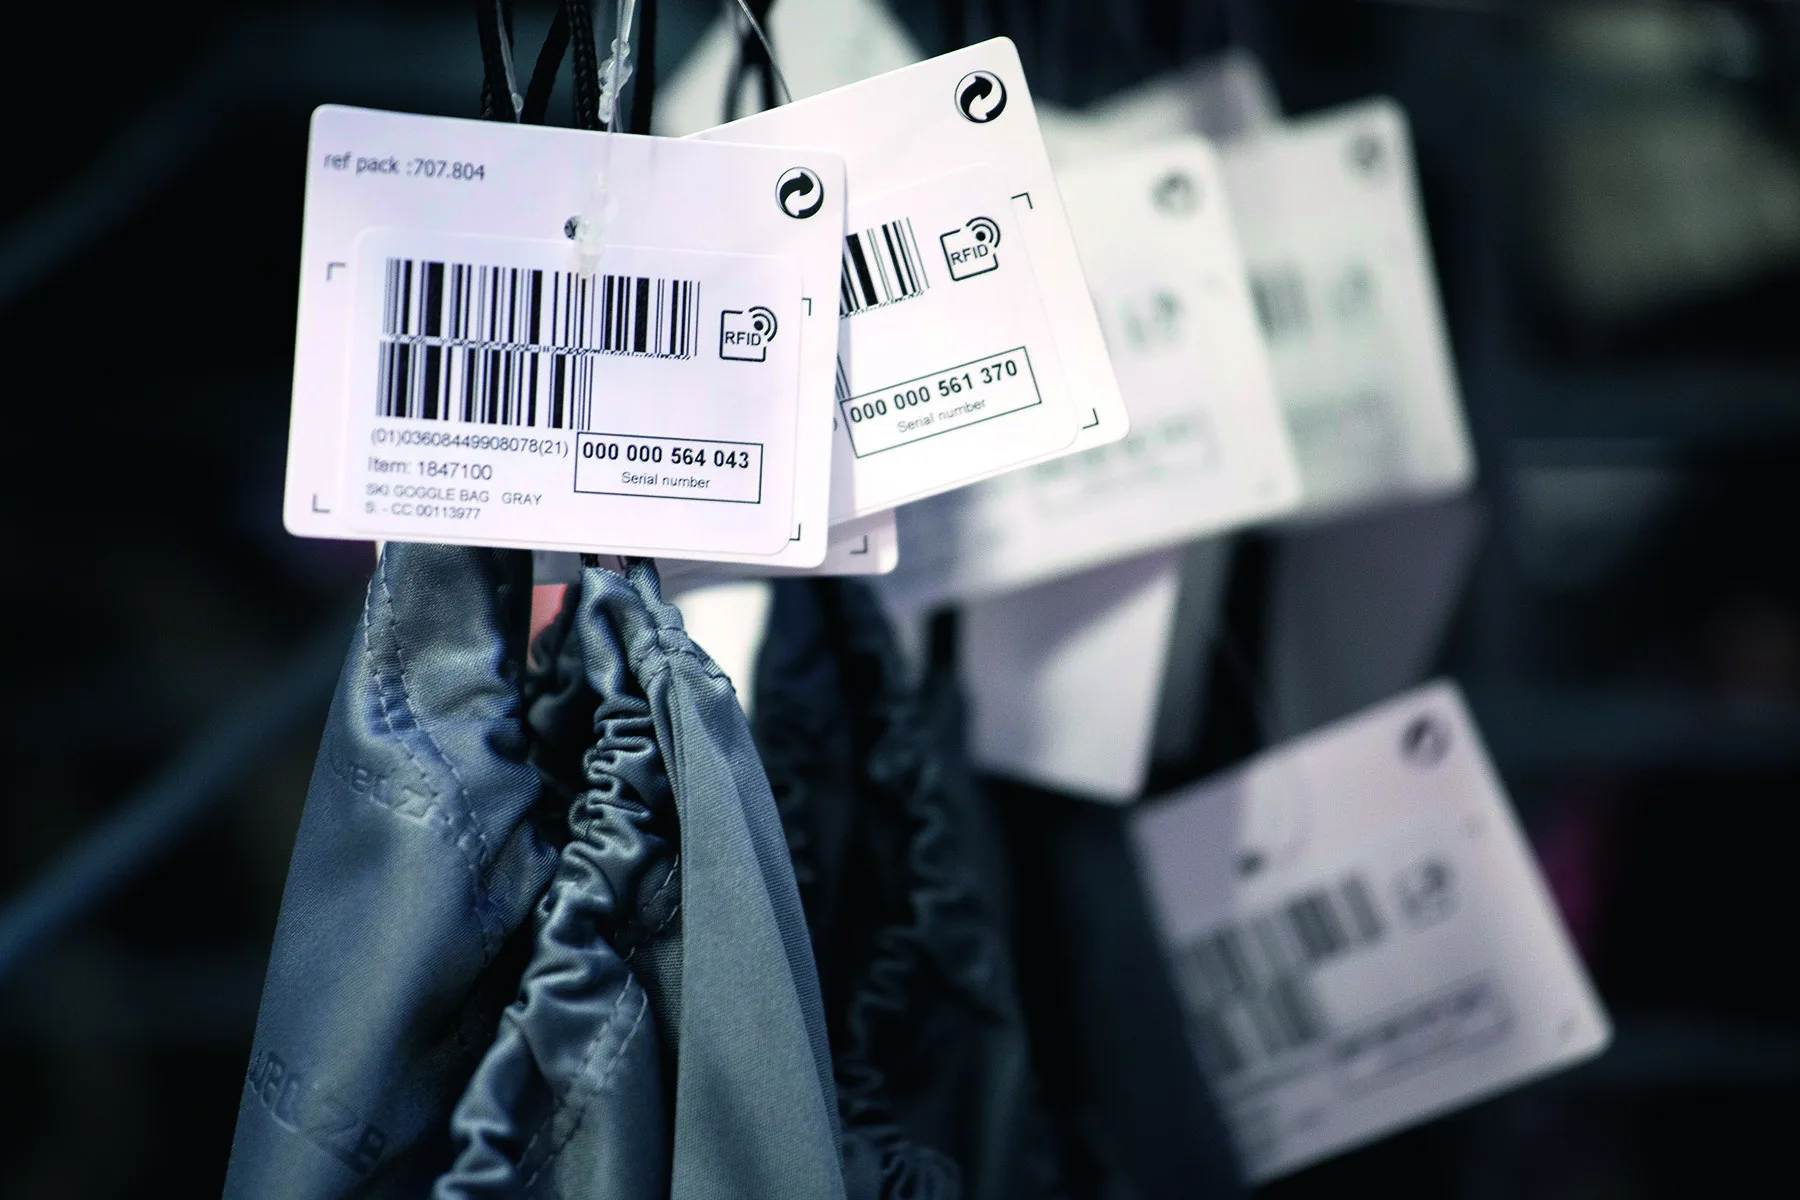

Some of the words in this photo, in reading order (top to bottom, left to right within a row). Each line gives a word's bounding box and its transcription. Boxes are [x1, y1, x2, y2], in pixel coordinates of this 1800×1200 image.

[323, 151, 352, 170] ref
[355, 155, 400, 175] pack
[950, 243, 989, 266] RFID
[724, 331, 762, 346] RFID
[850, 399, 888, 423] 000
[893, 386, 931, 410] 000
[937, 373, 974, 397] 561
[980, 359, 1018, 384] 370
[896, 414, 935, 433] Serial
[938, 398, 987, 421] number
[582, 441, 619, 460] 000
[626, 444, 663, 463] 000
[671, 447, 707, 467] 564
[713, 450, 750, 469] 043
[417, 460, 493, 481] 1847100
[621, 471, 659, 486] Serial
[662, 476, 711, 489] number
[392, 484, 456, 502] GOGGLE
[459, 489, 490, 503] BAG
[501, 492, 543, 506] GRAY
